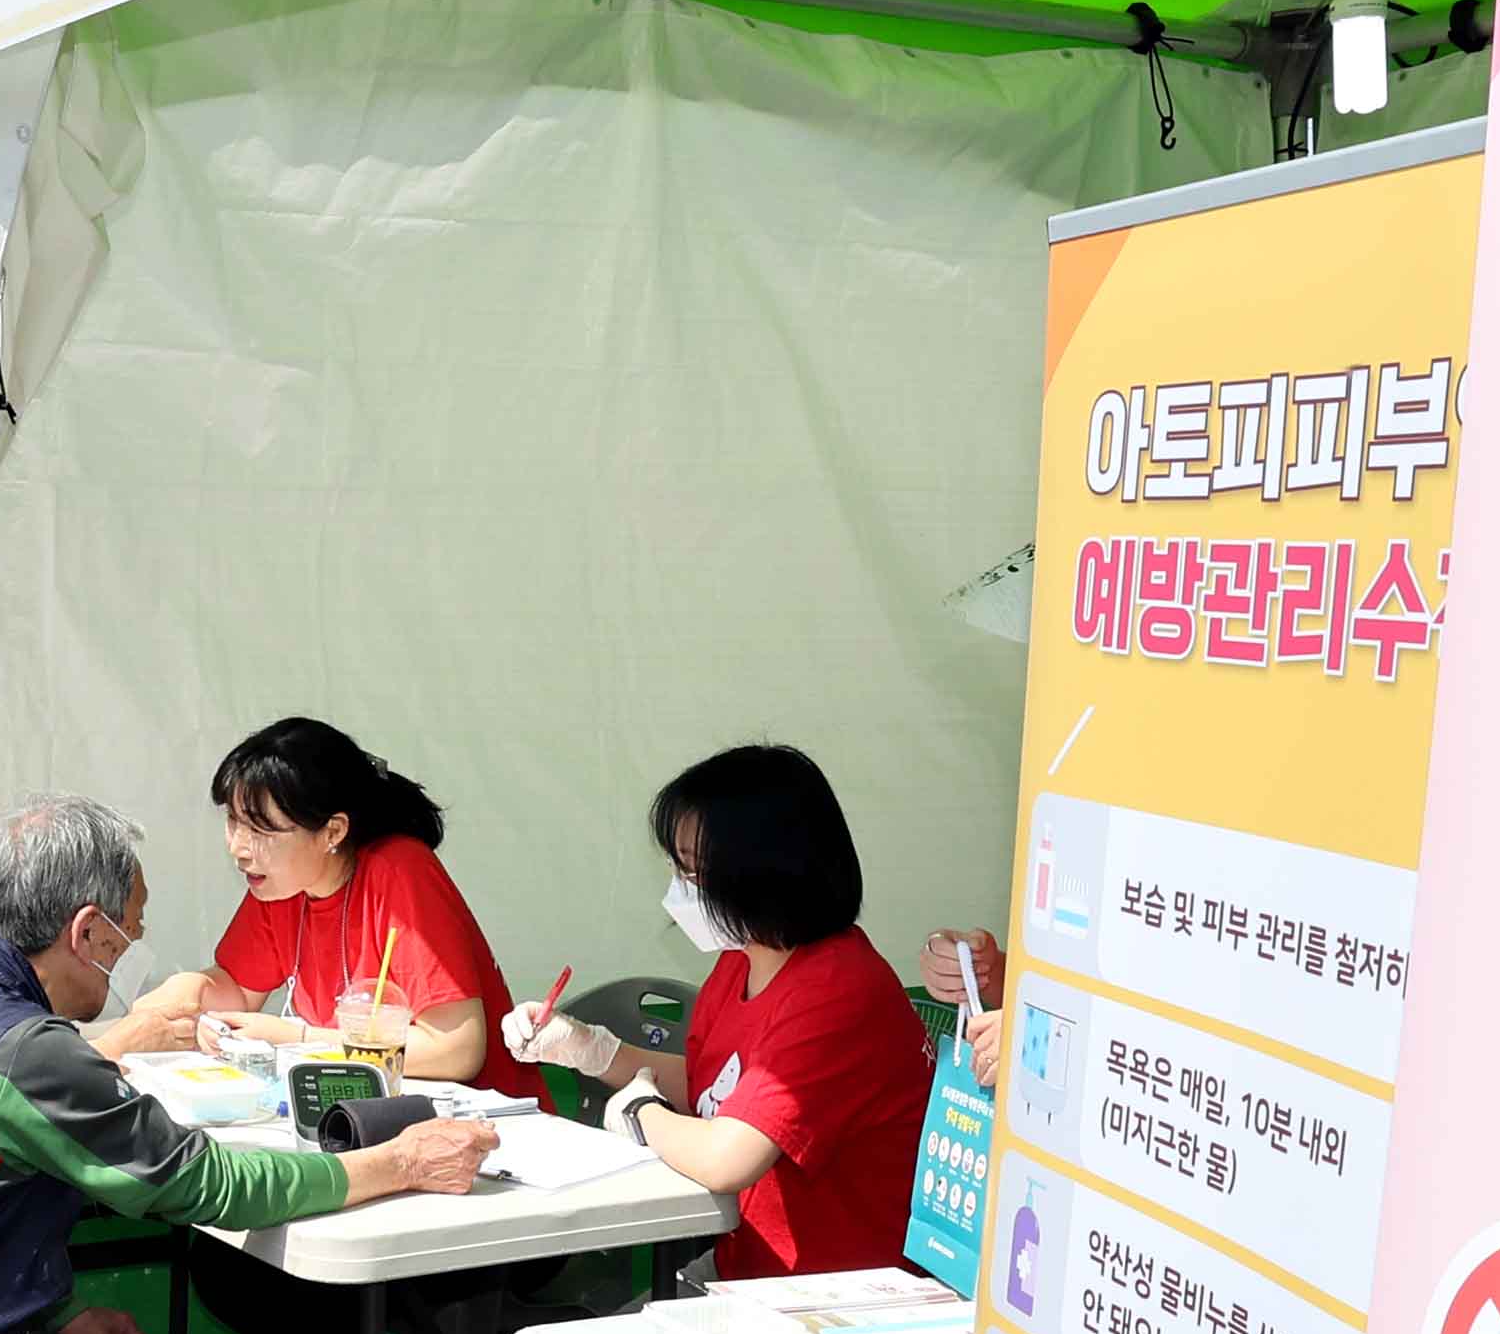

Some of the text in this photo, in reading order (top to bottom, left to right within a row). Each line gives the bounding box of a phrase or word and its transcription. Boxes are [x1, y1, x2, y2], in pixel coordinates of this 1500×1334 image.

[1085, 356, 1468, 503] 아토피피부
[1072, 537, 1450, 682] 예방관리수
[1120, 877, 1166, 930] 보습
[1173, 890, 1198, 937] 및
[1201, 898, 1250, 952] 피부
[1255, 912, 1328, 977] 관리를
[1099, 1097, 1239, 1196] (미지근한 물)
[1106, 1038, 1348, 1176] 목욕은 매일, 10분 내외
[1081, 1290, 1103, 1333] 안
[1088, 1228, 1154, 1301] 약산성
